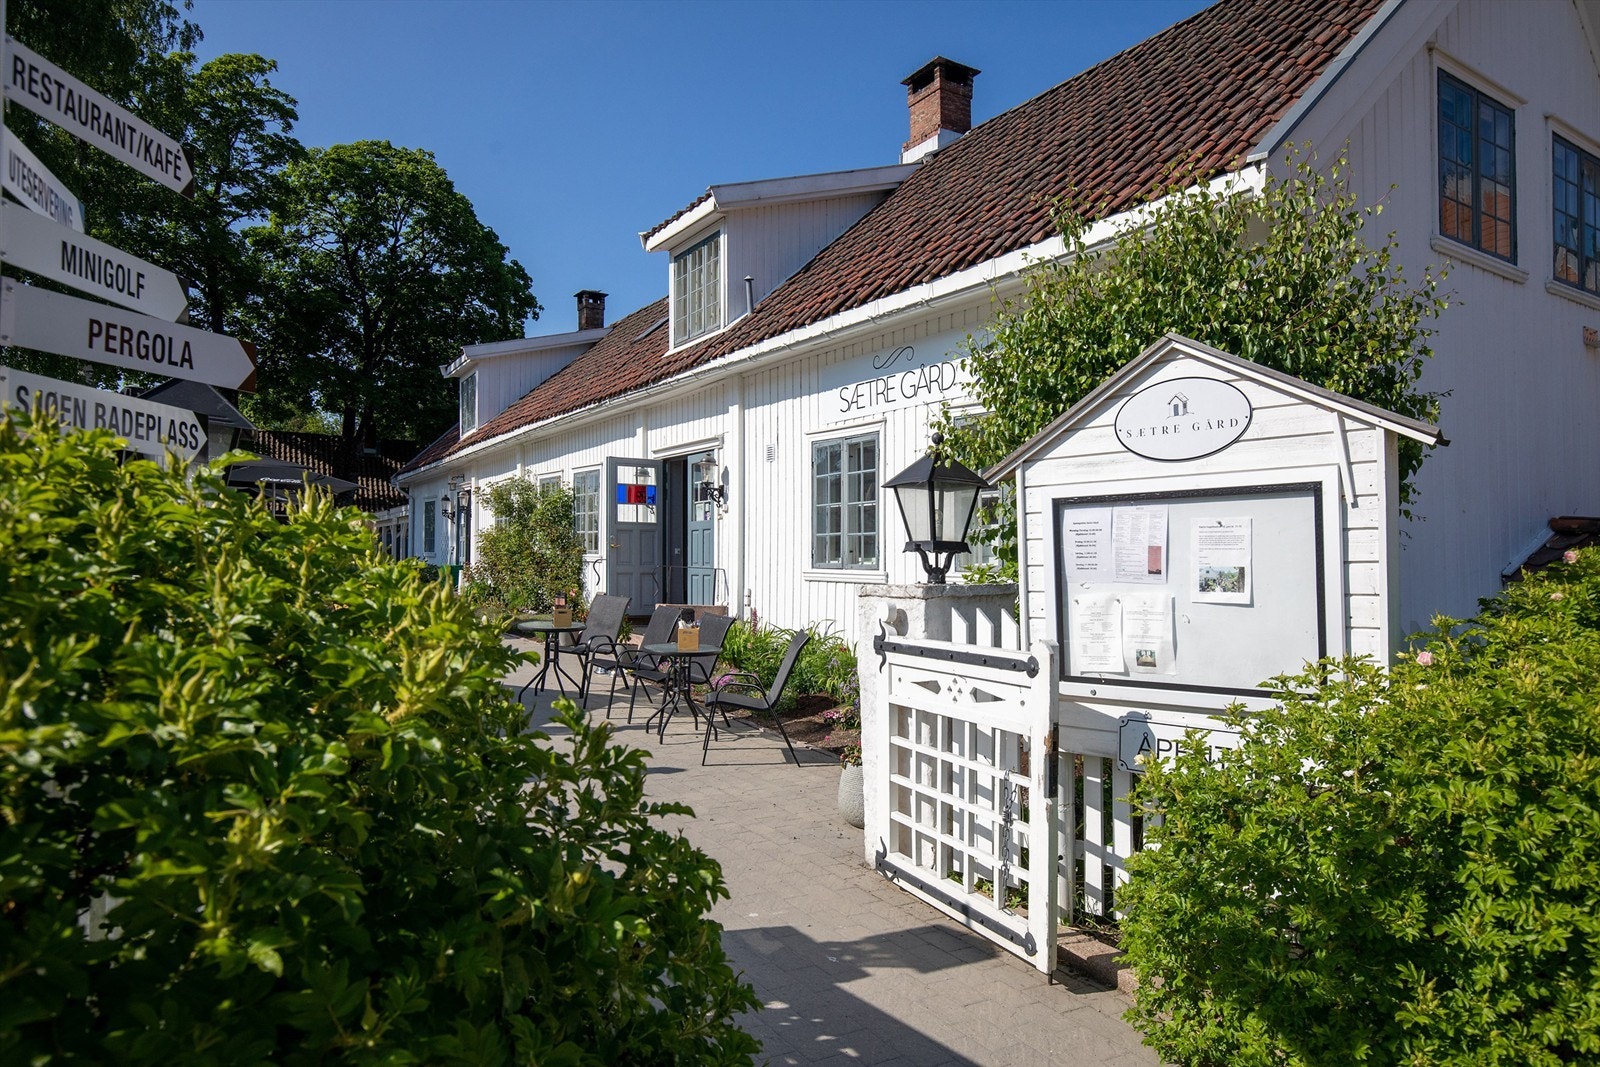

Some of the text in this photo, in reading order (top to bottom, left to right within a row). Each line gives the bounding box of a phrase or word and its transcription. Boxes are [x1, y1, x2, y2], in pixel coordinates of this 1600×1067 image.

[12, 54, 183, 183] RESTAURANT/KAFÉ
[9, 149, 73, 229] UTESERVERING
[61, 240, 145, 300] MINIGOLF
[88, 318, 194, 370] PERGOLA
[839, 361, 956, 413] SÆTRE GÅRD
[94, 401, 199, 450] BADEPLASS
[1126, 417, 1239, 439] SÆTRE GÅRD
